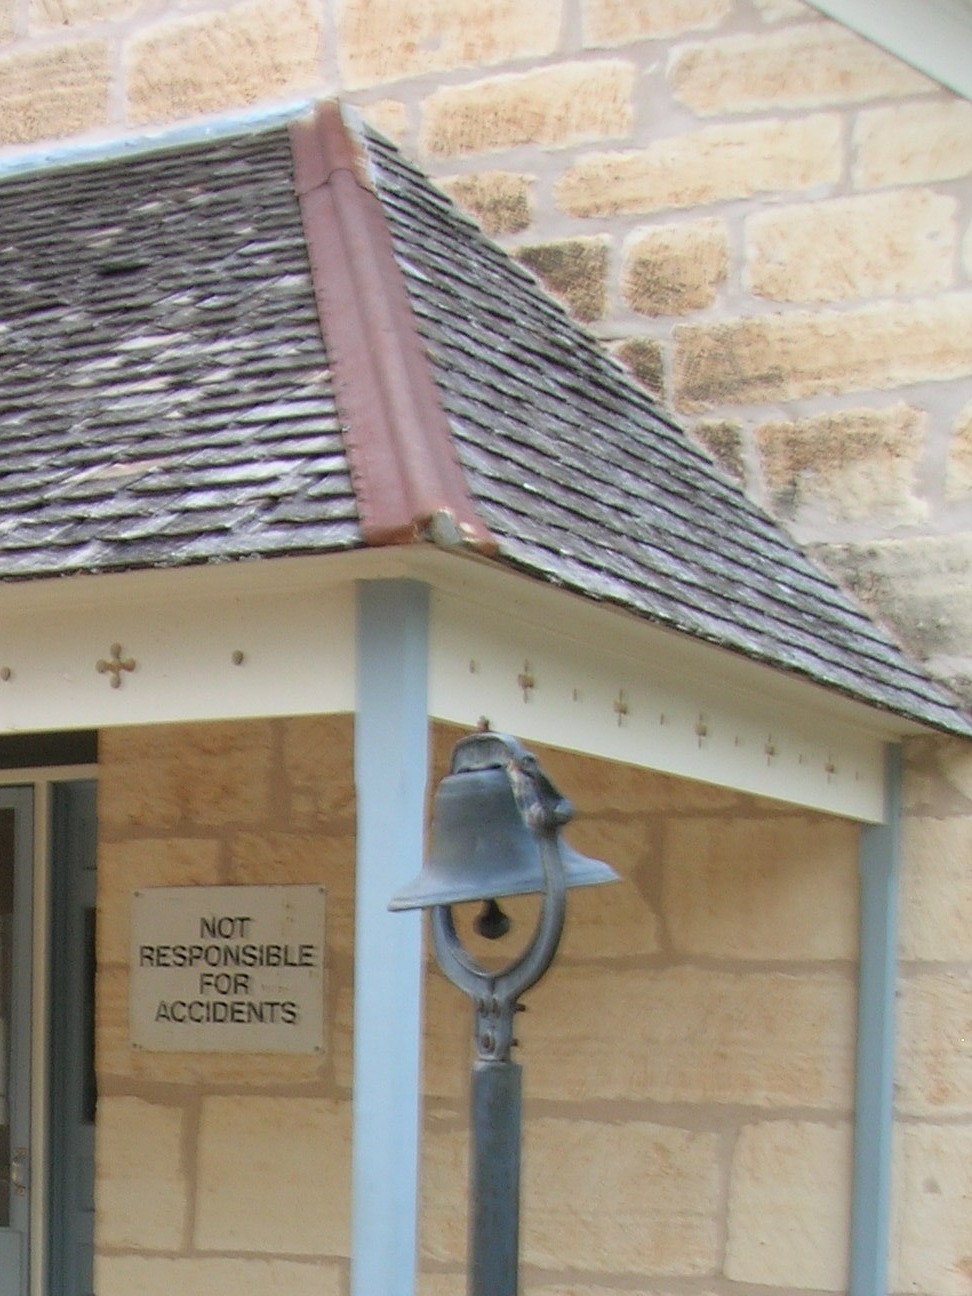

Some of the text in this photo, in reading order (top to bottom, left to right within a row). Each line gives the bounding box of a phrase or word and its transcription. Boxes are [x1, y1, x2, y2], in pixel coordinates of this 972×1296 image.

[200, 916, 253, 940] NOT
[139, 944, 315, 968] RESPONSIBLE
[199, 972, 251, 995] FOR
[154, 1000, 298, 1025] ACCIDENTS
